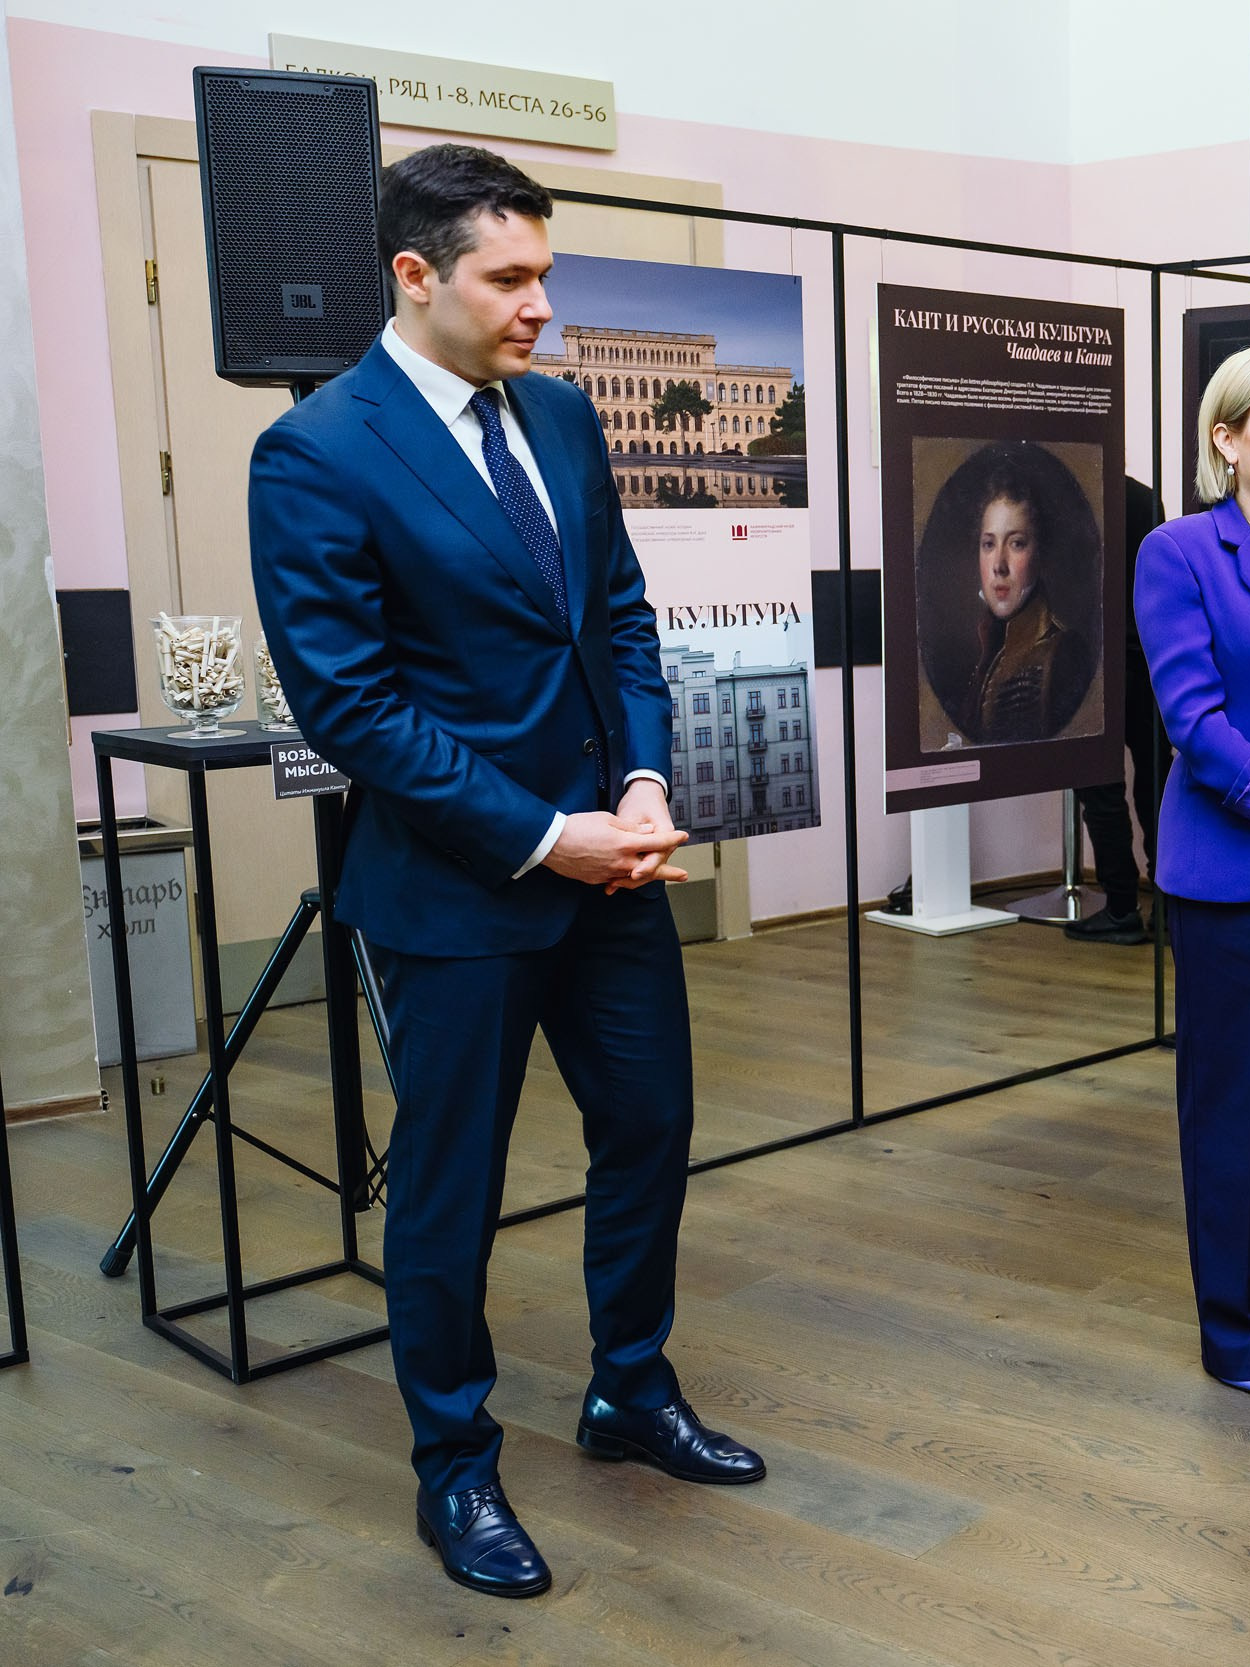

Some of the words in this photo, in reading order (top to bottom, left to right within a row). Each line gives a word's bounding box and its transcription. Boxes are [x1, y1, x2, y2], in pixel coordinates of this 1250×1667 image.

[389, 77, 430, 101] РЯД
[479, 90, 545, 115] МЕСТА
[549, 100, 608, 123] 26-56
[290, 294, 316, 309] JBL
[894, 308, 941, 330] КАНТ
[945, 313, 959, 332] И
[962, 315, 1035, 340] РУССКАЯ
[1039, 322, 1112, 346] КУЛЬТУРА
[1006, 342, 1062, 363] Чаадаев
[1063, 350, 1073, 364] и
[1075, 348, 1112, 367] Кант
[668, 602, 801, 630] КУЛЬТУРА
[97, 918, 156, 939] хлл
